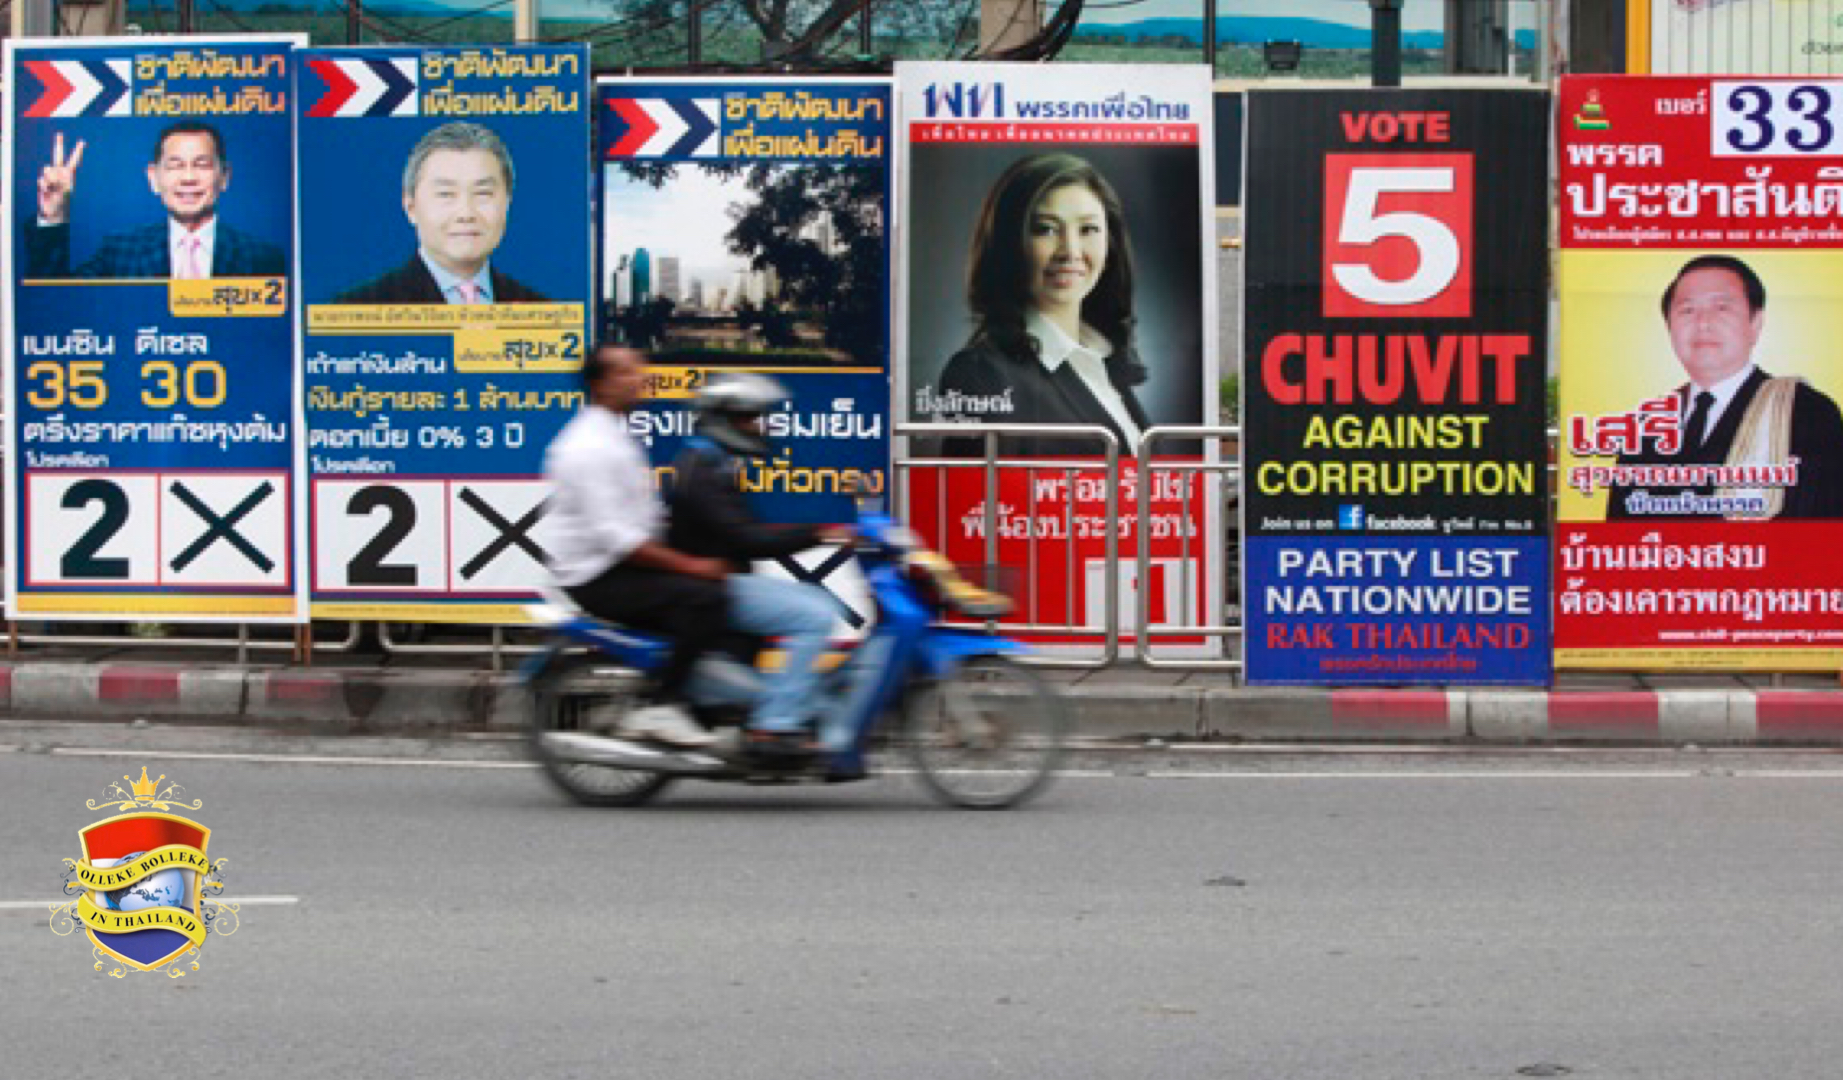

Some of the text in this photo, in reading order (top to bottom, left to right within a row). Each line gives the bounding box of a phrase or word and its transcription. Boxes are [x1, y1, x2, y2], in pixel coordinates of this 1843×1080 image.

[134, 50, 285, 79] ชาติพัฒนา
[421, 48, 579, 78] ชาติพัฒนา
[134, 80, 285, 115] เพื่อแผ่นดิน
[421, 79, 579, 117] เพื่อแผ่นดิน
[724, 90, 884, 121] ชาติพัฒนา
[1016, 91, 1190, 120] พรรคเพื่อไทย
[1340, 111, 1451, 142] VOTE
[1655, 85, 1834, 153] เบอร์ 33
[724, 122, 884, 157] เพื่อแผ่นดิน
[1567, 142, 1664, 167] พรรค
[1332, 166, 1461, 305] 5
[24, 326, 209, 355] เบนซิน ดีเซล
[26, 360, 228, 409] 35 30
[1261, 331, 1534, 405] CHUVIT
[307, 382, 587, 418] เงินกู้รายละ 1 ล้านบาท
[308, 413, 526, 449] ดอกเบี้ย 0% 3 ปี
[1303, 414, 1489, 448] AGAINST
[1569, 391, 1685, 456] เสรี
[1257, 461, 1534, 495] CORRUPTION
[60, 479, 130, 579] 2
[346, 485, 418, 586] 2
[1261, 516, 1291, 530] Join
[1368, 514, 1436, 530] facebook
[1278, 548, 1519, 577] PARTY LIST
[1560, 531, 1767, 570] บ้านเมืองสงบ
[1265, 585, 1532, 615] NATIONWIDE
[1266, 623, 1530, 649] RAK THAILAND
